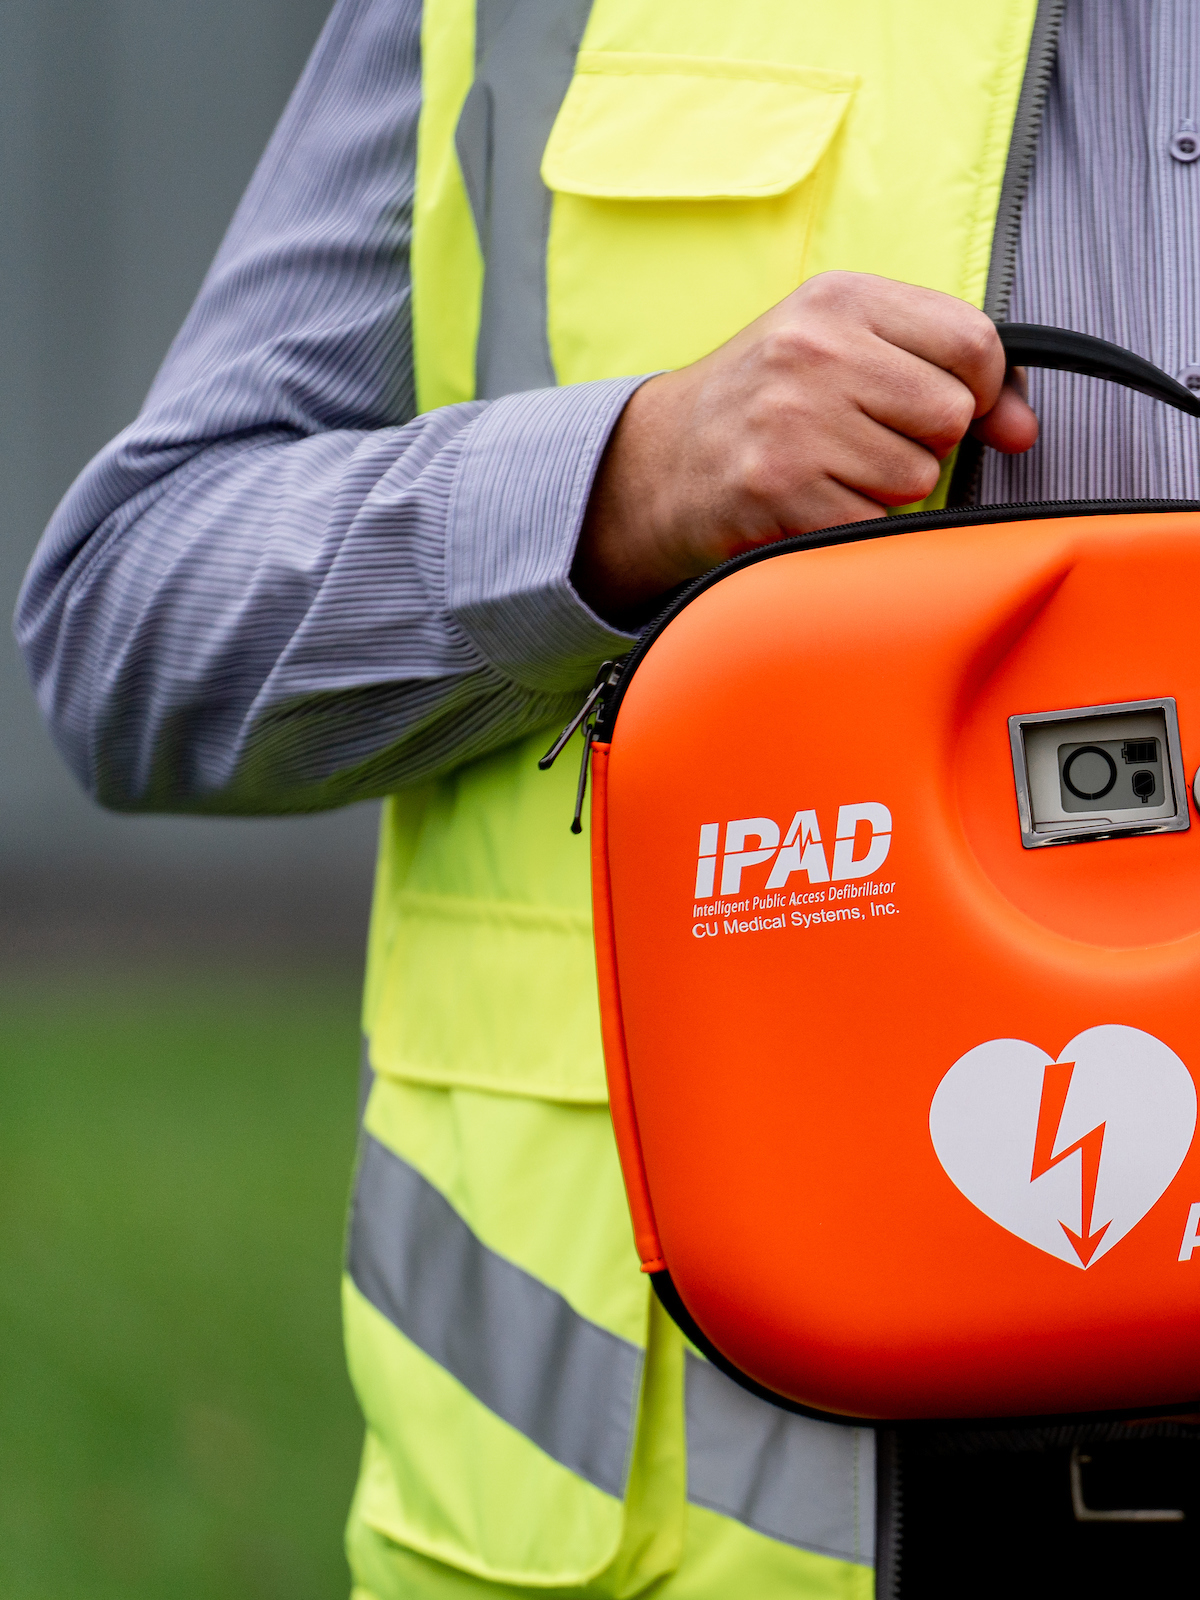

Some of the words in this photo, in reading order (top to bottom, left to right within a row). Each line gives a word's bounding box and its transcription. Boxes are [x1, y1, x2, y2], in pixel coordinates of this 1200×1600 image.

[694, 801, 893, 899] IPAD
[692, 898, 751, 918] Intelligent
[752, 893, 787, 911] Public
[789, 889, 826, 906] Access
[828, 880, 896, 900] Defibrillator
[691, 921, 719, 939] CU
[724, 914, 787, 935] Medical
[791, 905, 867, 929] Systems,
[870, 900, 900, 917] Inc.
